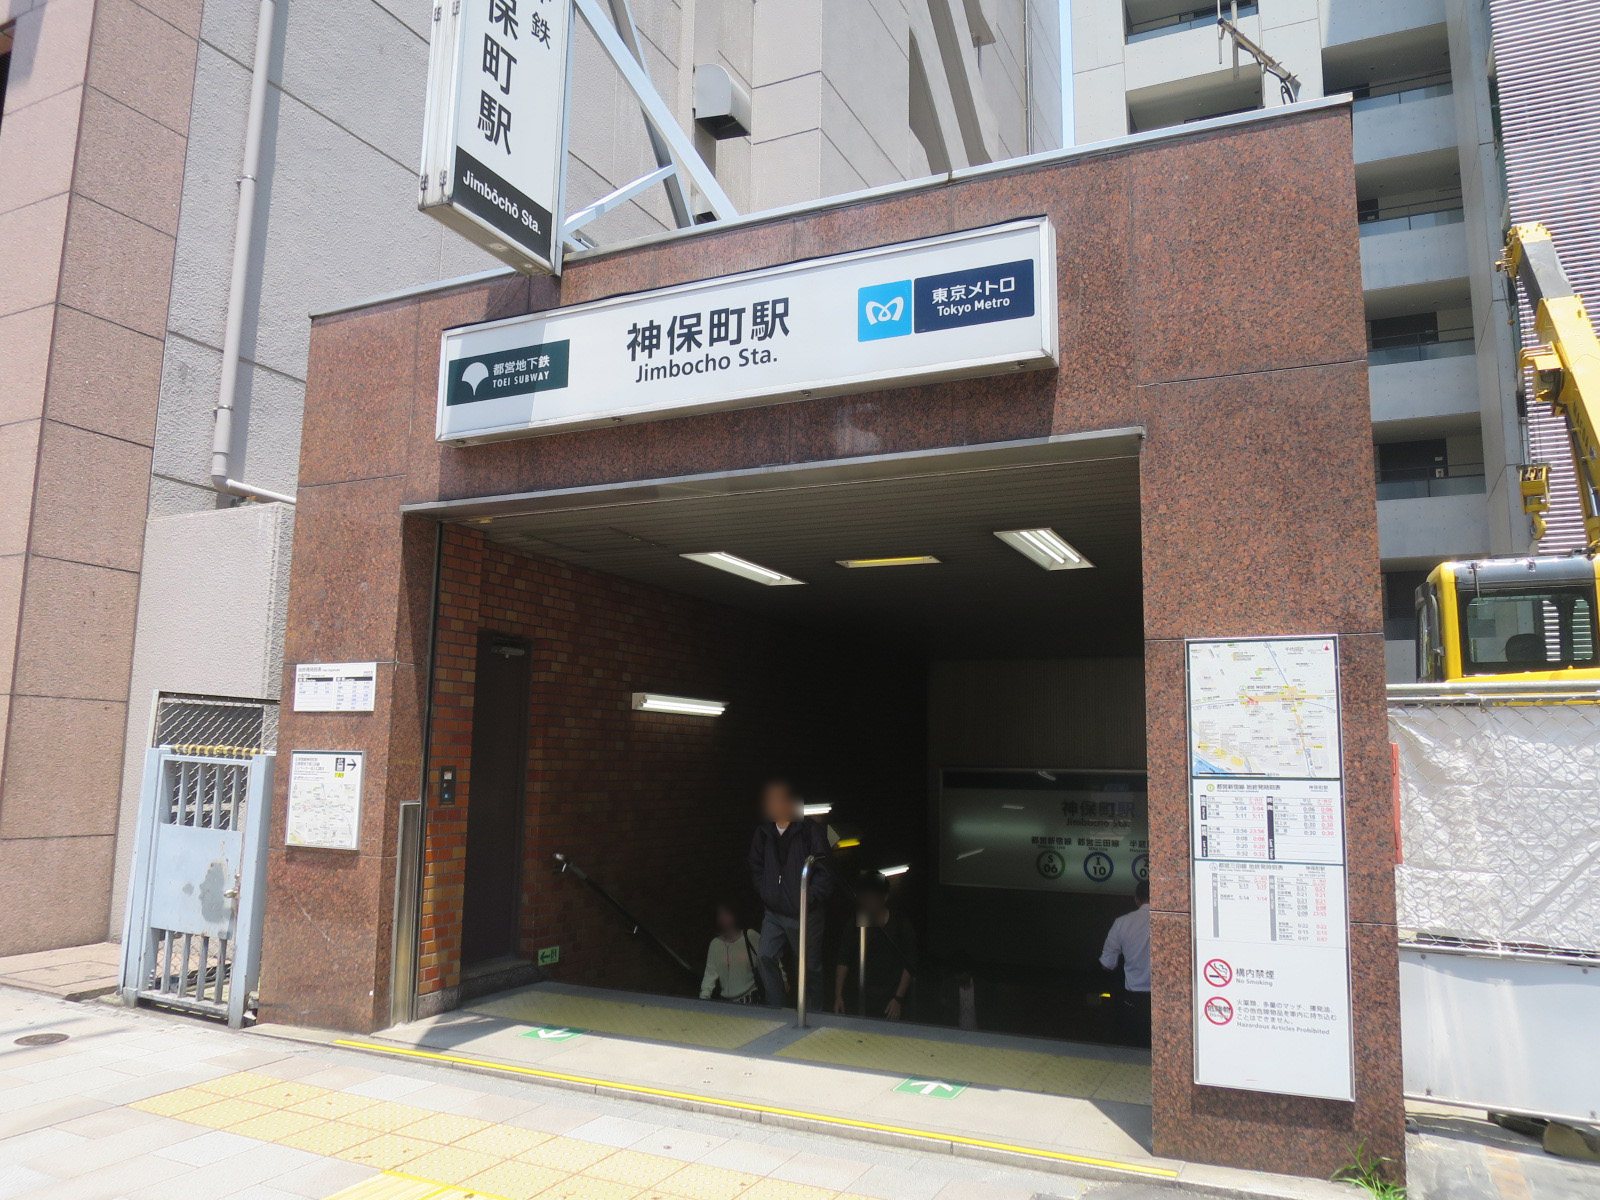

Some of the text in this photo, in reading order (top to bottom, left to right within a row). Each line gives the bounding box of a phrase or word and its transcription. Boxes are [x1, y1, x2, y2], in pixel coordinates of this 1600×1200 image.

[463, 170, 541, 235] Jimbōchō Sta.
[931, 277, 1015, 304] 東京メトロ
[937, 297, 1010, 317] Tokyo Metro
[626, 297, 790, 362] 神保町駅
[492, 354, 551, 376] 都営地下鉄
[635, 348, 778, 383] Jimbocho Sta.
[492, 371, 550, 388] TOEI SUBWAY
[1062, 800, 1135, 818] 神保町駅
[1031, 836, 1072, 846] 都営新宿線
[1077, 838, 1120, 847] 都営三田線
[1047, 855, 1054, 863] S
[1043, 864, 1058, 873] 06
[1092, 866, 1106, 876] 10
[1236, 968, 1275, 979] 構内禁煙
[1246, 979, 1273, 987] Smoking
[1237, 1006, 1337, 1021] その他危険物品を車内に持ち込む
[1237, 1014, 1294, 1025] ことはできません。
[1237, 1022, 1270, 1030] Hazardous
[1297, 1027, 1330, 1035] Prohibited
